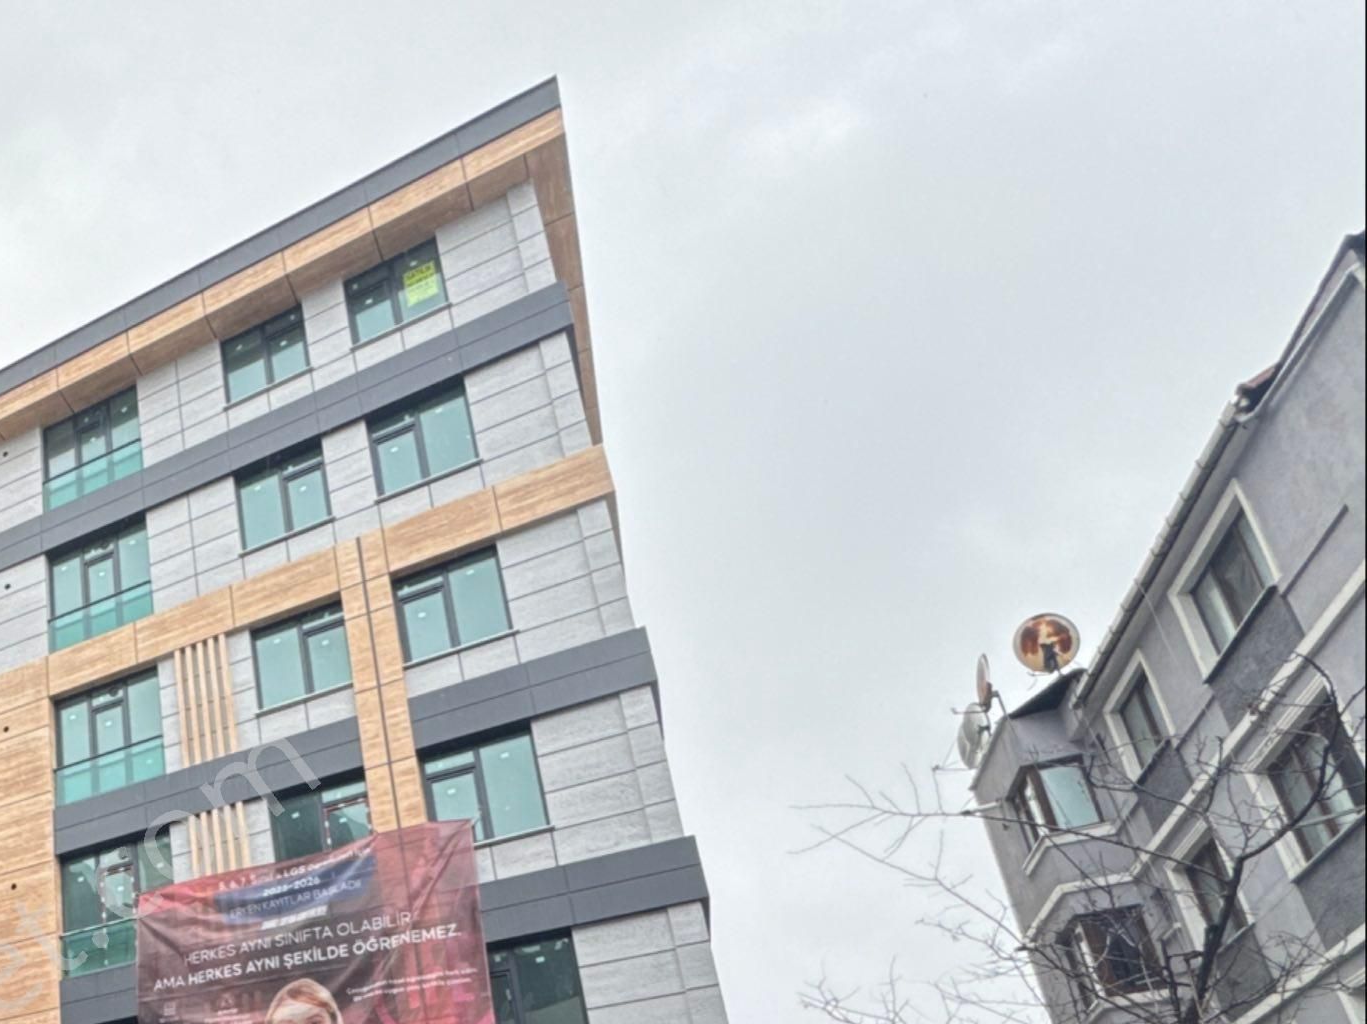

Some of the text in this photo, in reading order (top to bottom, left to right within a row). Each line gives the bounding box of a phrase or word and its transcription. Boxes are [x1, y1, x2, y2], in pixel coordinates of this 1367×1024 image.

[154, 975, 185, 992] AMA
[188, 963, 243, 986] HERKES
[245, 956, 280, 974] AYNI
[283, 943, 349, 970] ŞEKİLDE
[185, 945, 237, 967] HERKES
[239, 938, 272, 957] AYNI
[275, 927, 334, 948] SINIFTA
